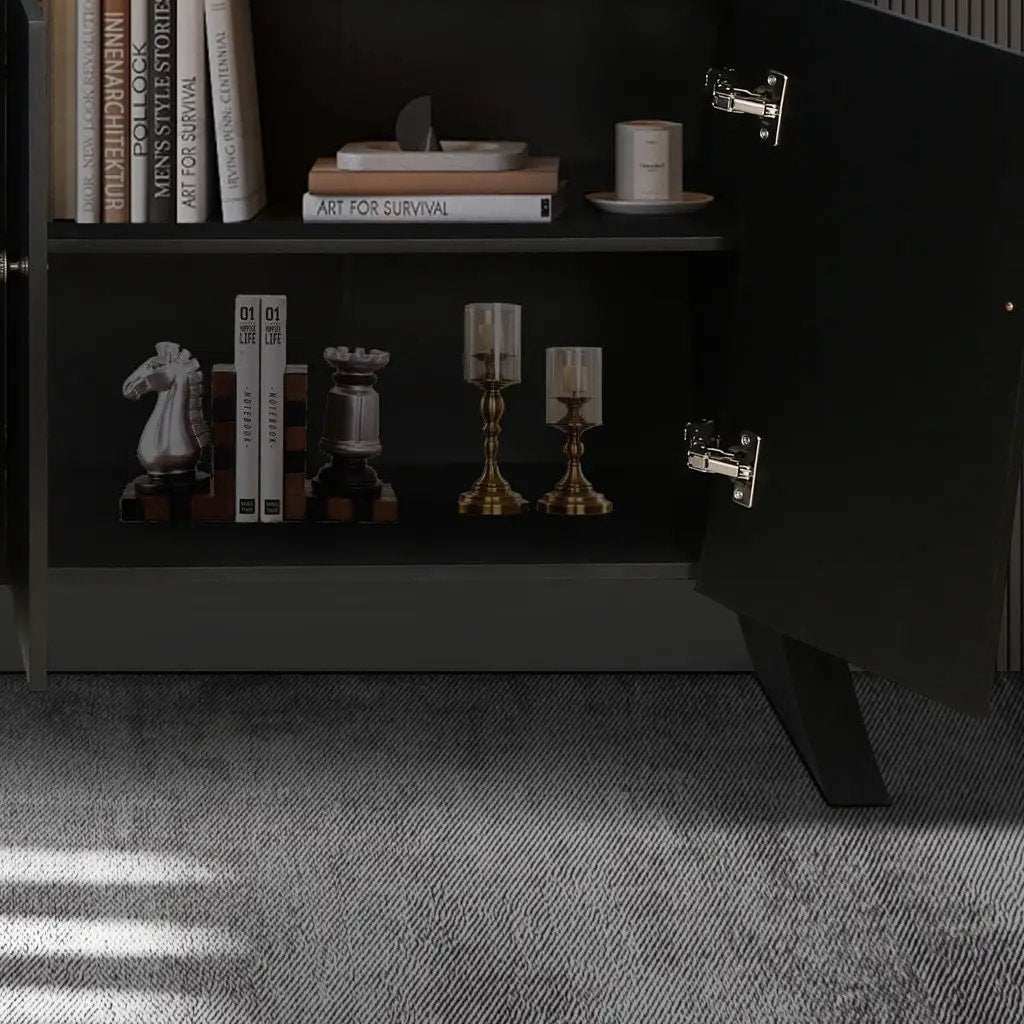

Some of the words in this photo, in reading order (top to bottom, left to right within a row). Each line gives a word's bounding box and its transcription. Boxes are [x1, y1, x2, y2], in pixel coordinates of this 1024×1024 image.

[217, 31, 231, 104] CENTENNIAL
[83, 90, 95, 131] LOOK
[103, 12, 125, 211] INNENARCHITEKTUR
[132, 42, 149, 157] POLLOCK
[154, 76, 171, 136] STYLE
[181, 76, 197, 143] SURVIVAL
[83, 139, 95, 169] NEW
[154, 139, 171, 199] MEN'S
[181, 148, 196, 178] FOR
[181, 181, 196, 209] ART
[317, 200, 344, 216] ART
[350, 200, 379, 216] FOR
[383, 200, 449, 216] SURVIVAL
[239, 306, 255, 321] 01
[265, 307, 281, 322] 01
[239, 332, 256, 345] LIFE
[265, 332, 282, 345] LIFE
